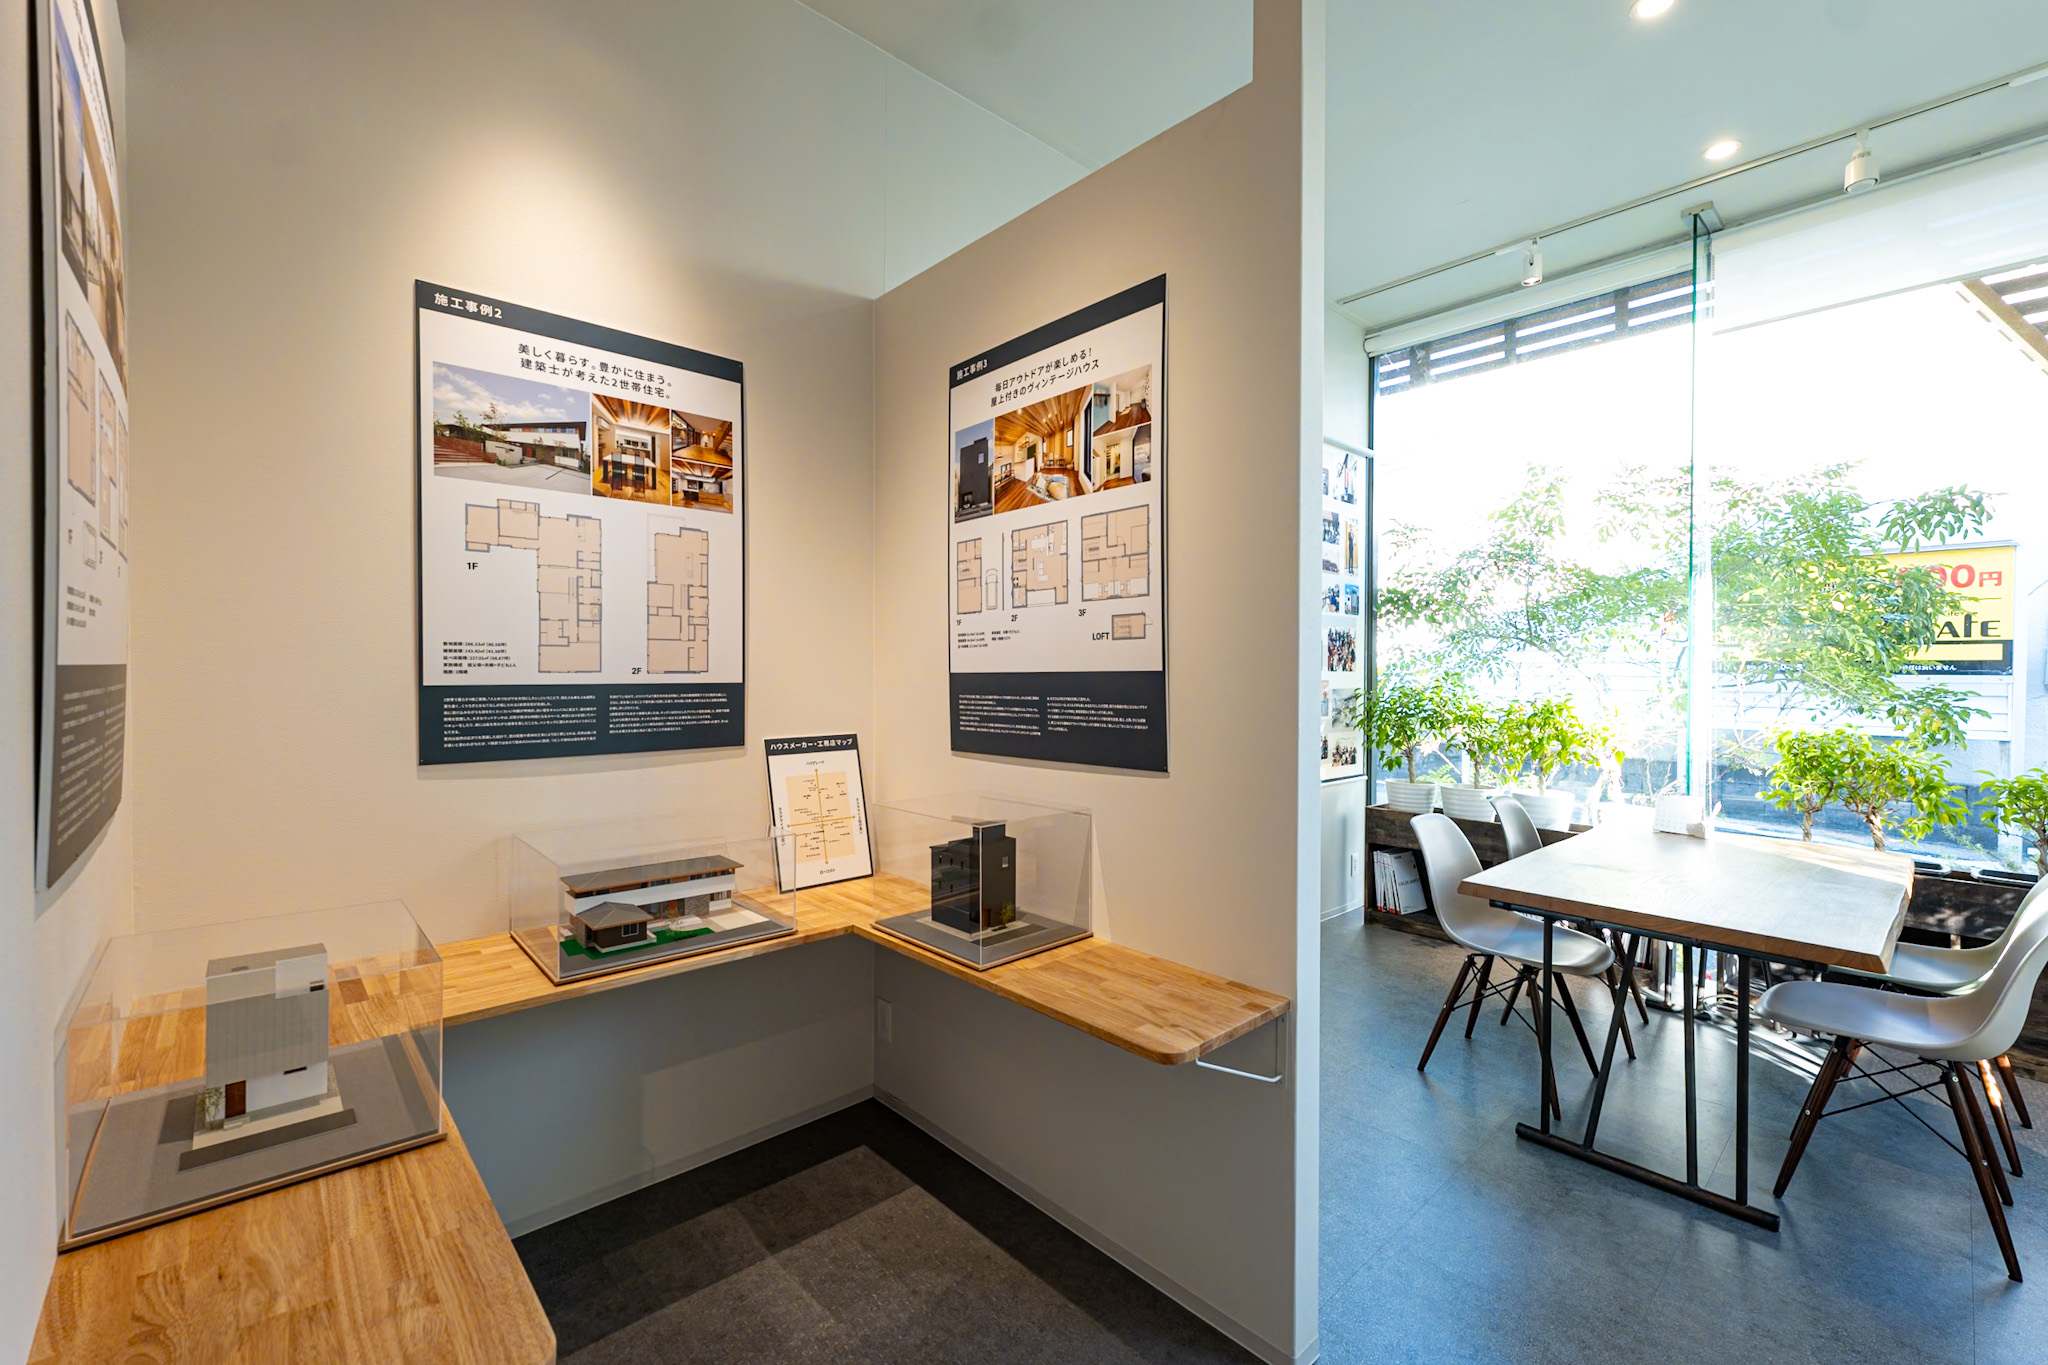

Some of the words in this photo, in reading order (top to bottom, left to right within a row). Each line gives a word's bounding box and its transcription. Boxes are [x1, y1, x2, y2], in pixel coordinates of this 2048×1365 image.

[434, 292, 503, 319] 施工事例2
[517, 343, 672, 387] 美しく暮らす。豊かに住まう。
[956, 359, 988, 380] 施工事例3
[520, 358, 670, 399] 建築士が考えた2世帯住宅。
[990, 359, 1100, 407] 屋上付きのヴィンテージハウス
[466, 562, 478, 570] 1F
[1078, 609, 1087, 617] 3F
[1092, 633, 1110, 641] LOFT
[631, 667, 642, 675] 2F
